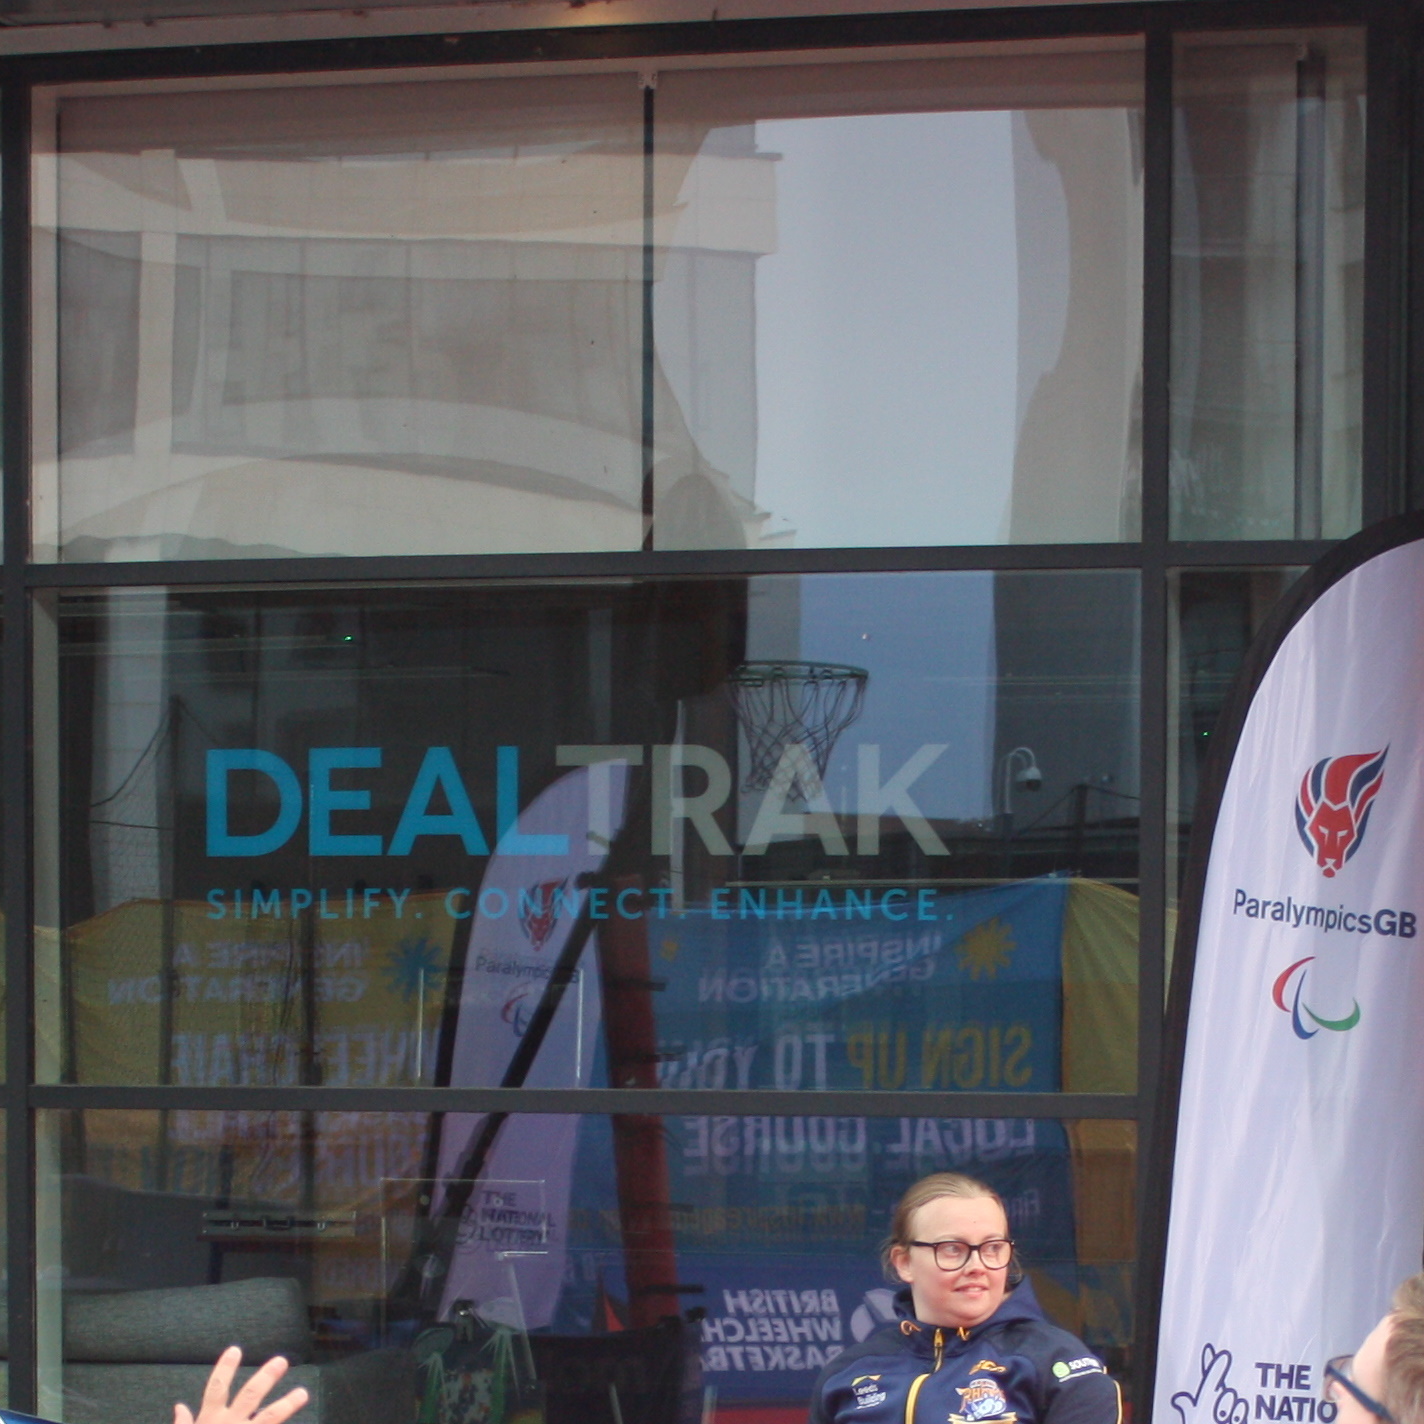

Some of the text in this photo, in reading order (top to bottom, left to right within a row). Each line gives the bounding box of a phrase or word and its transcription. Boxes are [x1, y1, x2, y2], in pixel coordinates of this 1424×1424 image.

[205, 886, 954, 921] SIMPLIFY. CONNECT. ENHANCE.
[1233, 888, 1417, 939] ParalympicsGB
[1254, 1361, 1312, 1390] THE
[1255, 1394, 1338, 1424] NATIO
